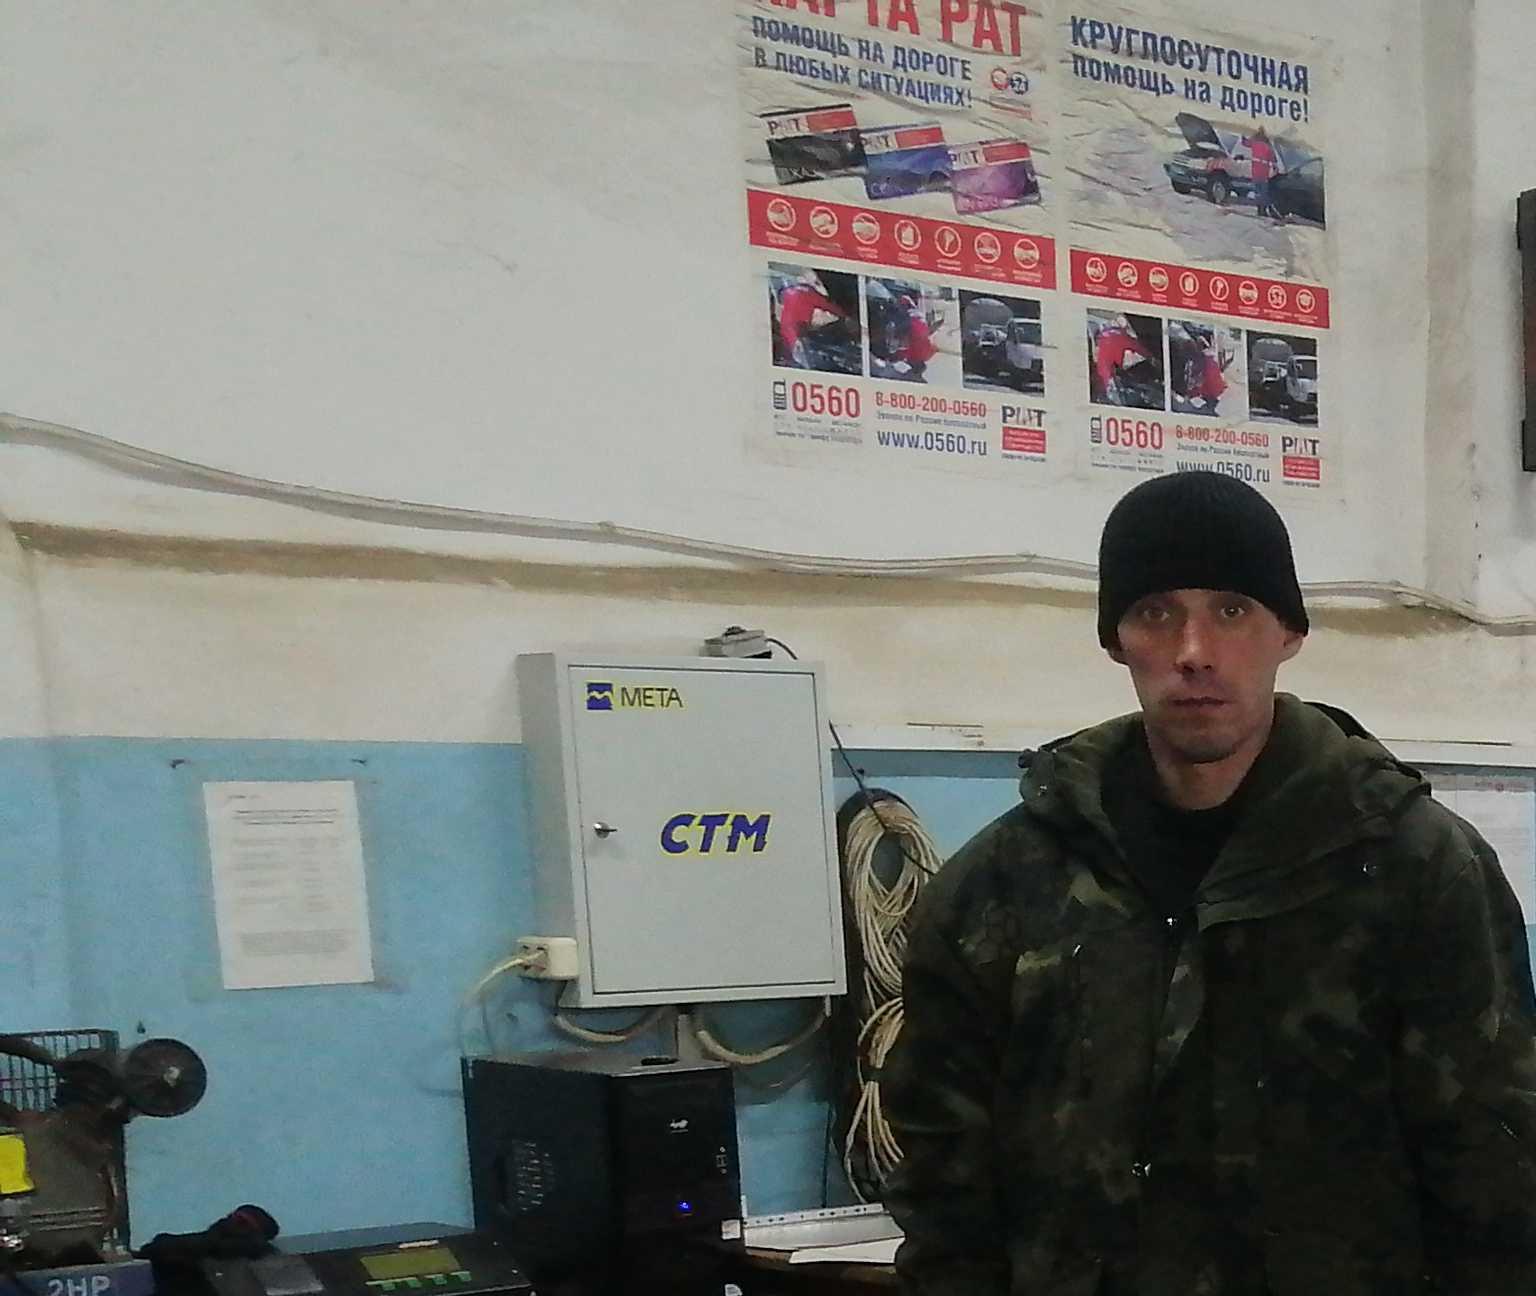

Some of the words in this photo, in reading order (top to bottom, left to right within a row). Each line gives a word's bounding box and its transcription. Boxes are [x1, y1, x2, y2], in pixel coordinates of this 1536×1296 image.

[752, 15, 850, 58] ПОМОЩЬ
[858, 38, 885, 65] НА
[892, 45, 971, 81] ДОРОГЕ
[1071, 15, 1309, 95] КРУГЛОСУТОЧНАЯ
[755, 47, 768, 68] В
[776, 51, 850, 86] ЛЮБЫХ
[858, 68, 973, 109] СИТУАЦИЯХ!
[1072, 53, 1175, 97] помощь
[1183, 77, 1211, 104] на
[1220, 84, 1309, 123] дороге!
[791, 381, 861, 418] 0560
[876, 391, 987, 418] 8-800-200-0560
[877, 429, 988, 456] www.0560.ru
[1106, 417, 1163, 450] 0560
[1175, 424, 1270, 448] 8-800-200-0560
[1176, 461, 1271, 484] www0560.ru
